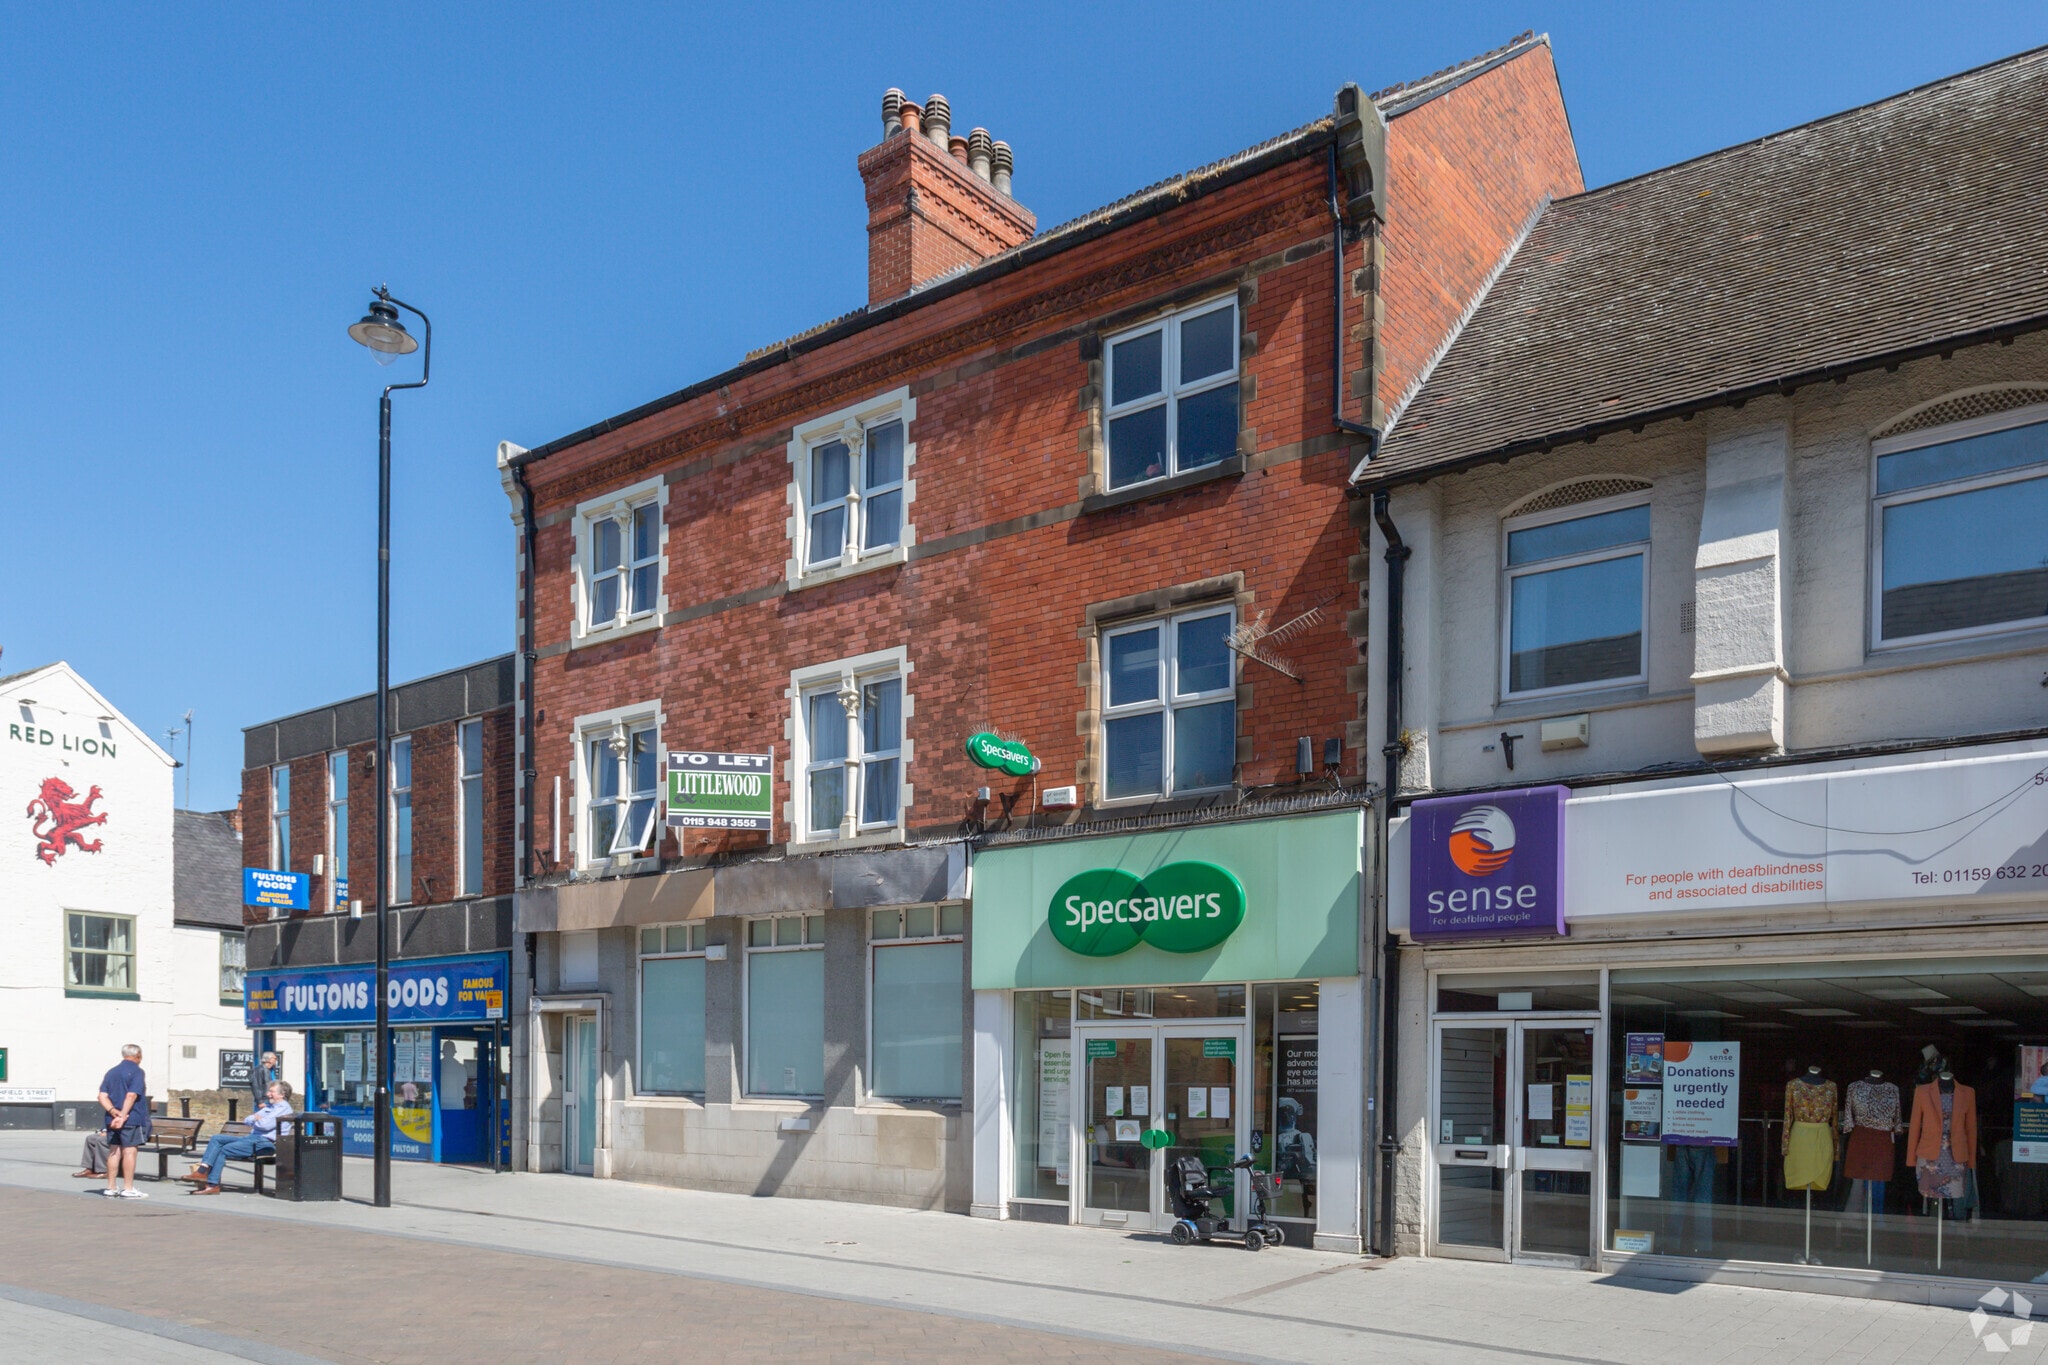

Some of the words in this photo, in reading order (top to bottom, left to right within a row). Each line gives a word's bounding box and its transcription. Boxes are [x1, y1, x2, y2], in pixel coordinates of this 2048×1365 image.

[9, 723, 54, 746] RED
[62, 734, 116, 759] LION
[981, 739, 1029, 766] Specsavers
[671, 753, 709, 765] TO
[718, 755, 768, 767] LET
[676, 772, 761, 796] LITTLEWOOD
[682, 817, 705, 825] 0115
[707, 818, 728, 827] 948
[730, 819, 757, 828] 3555
[252, 871, 297, 883] FULTONS
[1626, 874, 1648, 886] For
[1651, 870, 1694, 886] people
[1697, 868, 1724, 881] with
[1728, 862, 1824, 879] deafblindness
[1912, 871, 1938, 885] Tel:
[1943, 868, 1991, 883] 01159
[1996, 865, 2026, 880] 632
[257, 880, 293, 891] FOODS
[1648, 887, 1673, 901] and
[1676, 883, 1747, 899] associated
[1751, 878, 1824, 894] disabilities
[1427, 884, 1537, 914] sense
[1065, 892, 1221, 933] Specsavers
[1433, 917, 1447, 925] For
[1450, 914, 1495, 924] deafblind
[1497, 911, 1531, 924] people
[462, 977, 494, 989] FAMOUS
[285, 981, 368, 1012] FULTONS
[375, 976, 448, 1008] OODS
[458, 991, 473, 1002] FOR
[1044, 1051, 1061, 1059] Open
[1286, 1050, 1302, 1058] Our
[1286, 1059, 1318, 1067] advance
[1286, 1069, 1301, 1078] eye
[1667, 1066, 1735, 1078] Donations
[1286, 1077, 1301, 1086] has
[1303, 1077, 1318, 1086] lan
[1673, 1082, 1729, 1095] urgently
[1676, 1098, 1725, 1109] needed
[346, 1119, 375, 1129] HOUSEHO
[392, 1143, 420, 1154] FULTONS
